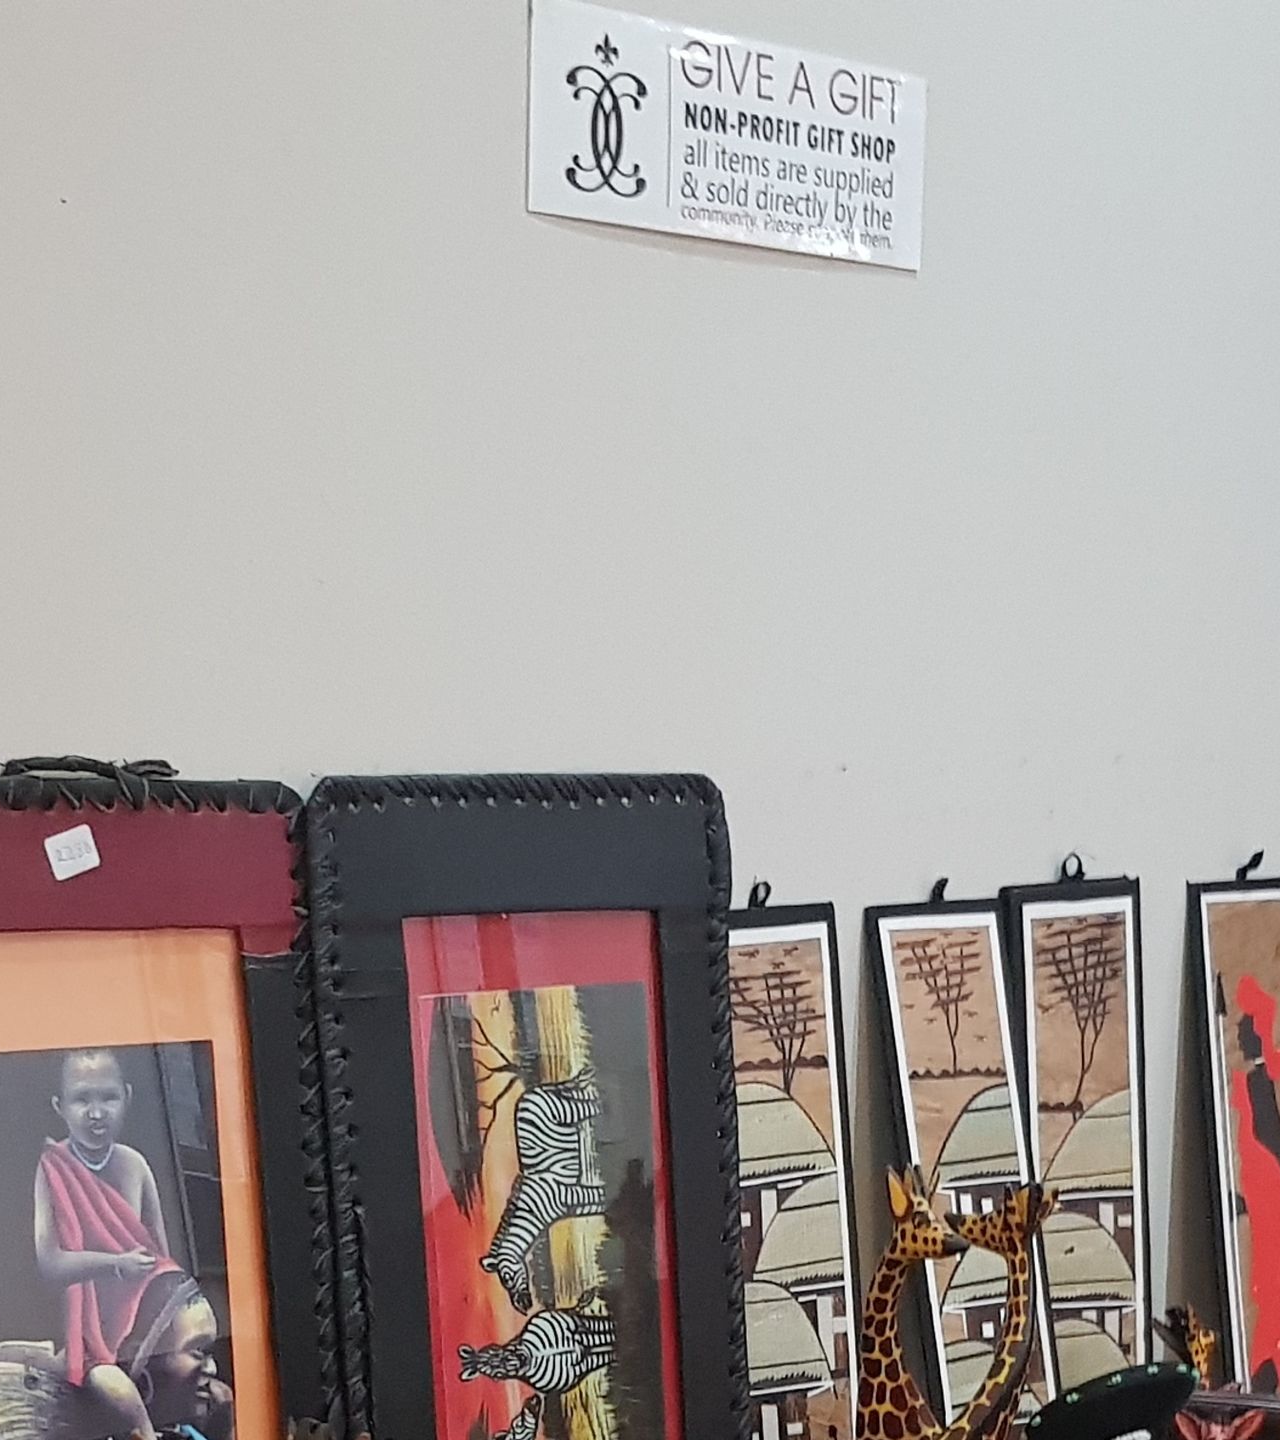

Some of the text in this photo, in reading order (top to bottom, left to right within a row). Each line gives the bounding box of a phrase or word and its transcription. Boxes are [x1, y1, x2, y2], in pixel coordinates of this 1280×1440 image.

[680, 40, 902, 124] GIVE A GIFT
[683, 101, 896, 164] NON-PROFIT GIFT SHOP
[683, 138, 894, 200] all items are supplied
[680, 171, 893, 231] & sold directly by the
